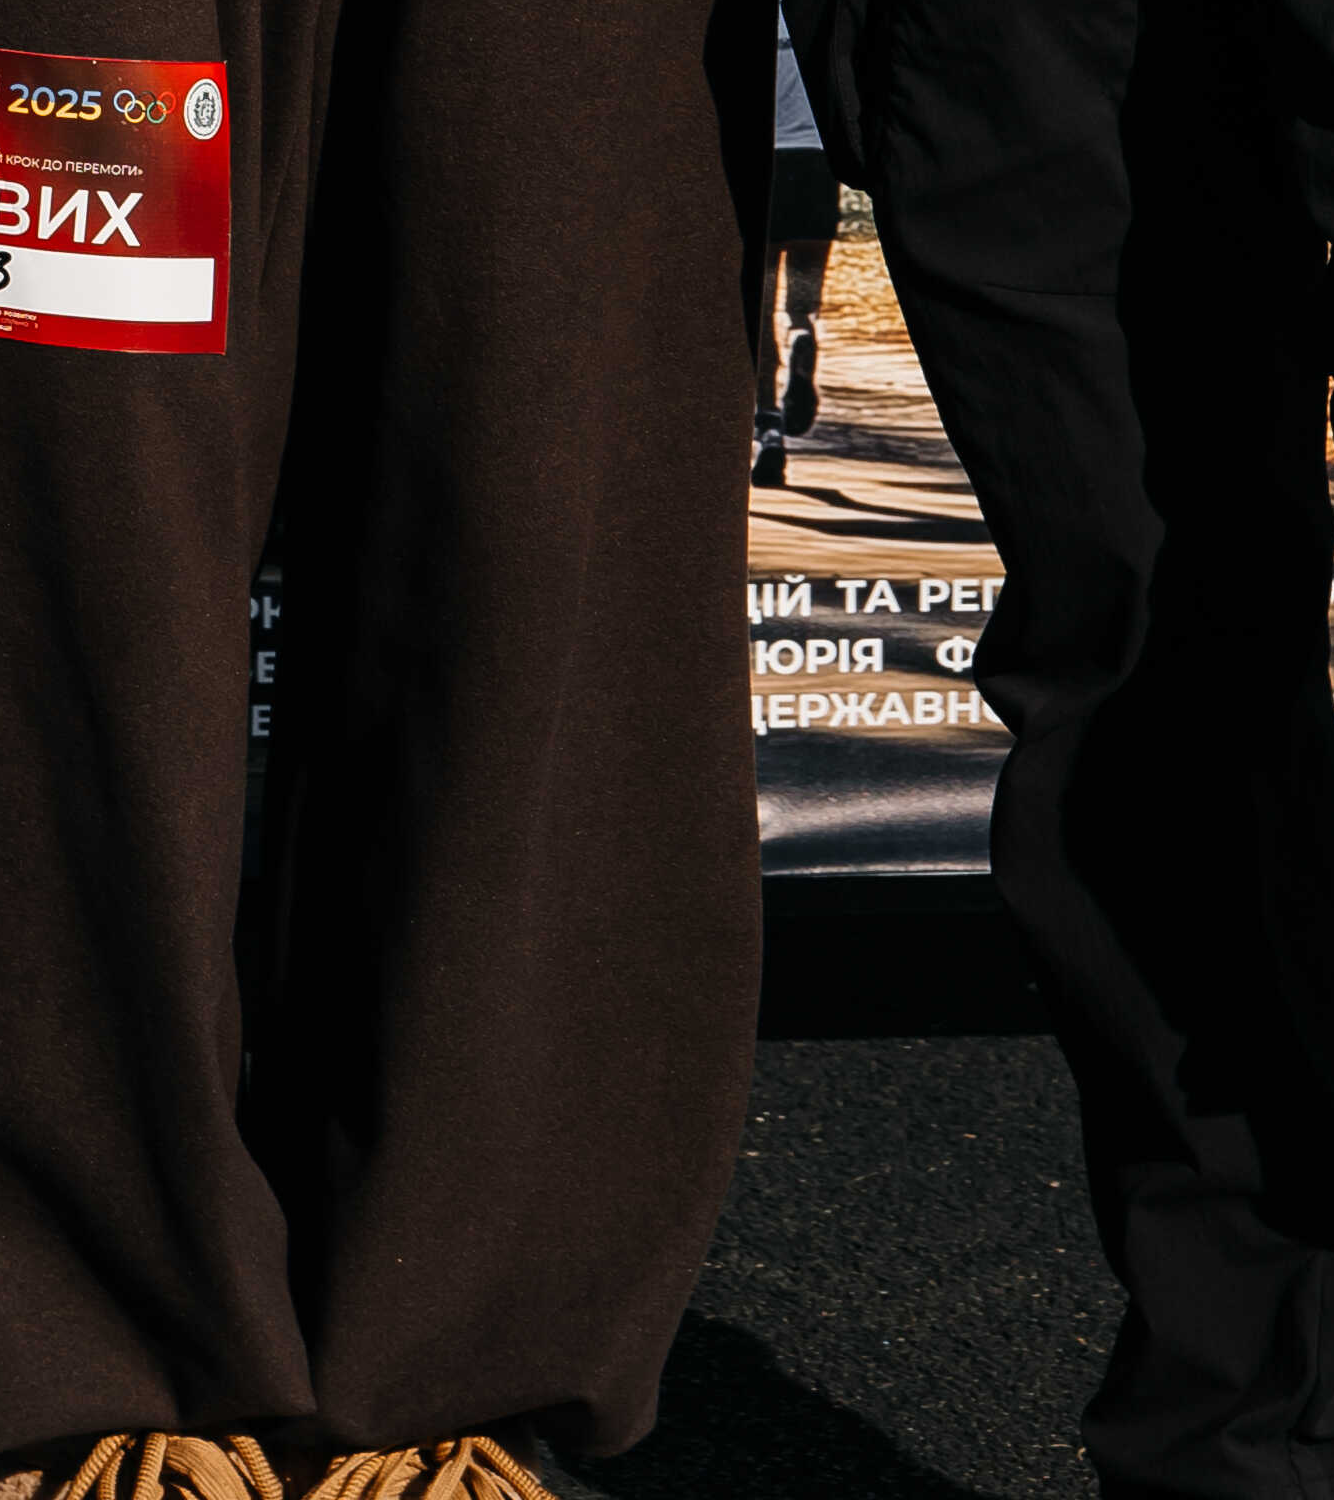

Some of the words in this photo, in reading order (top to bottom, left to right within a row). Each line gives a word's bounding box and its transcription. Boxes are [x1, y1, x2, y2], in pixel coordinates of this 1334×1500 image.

[7, 82, 103, 121] 2025
[5, 153, 41, 169] КРОК
[41, 158, 63, 172] ДО
[65, 160, 144, 177] ПЕРЕМОГИ»
[835, 579, 902, 614] ТА
[754, 638, 884, 676] ЮРІЯ
